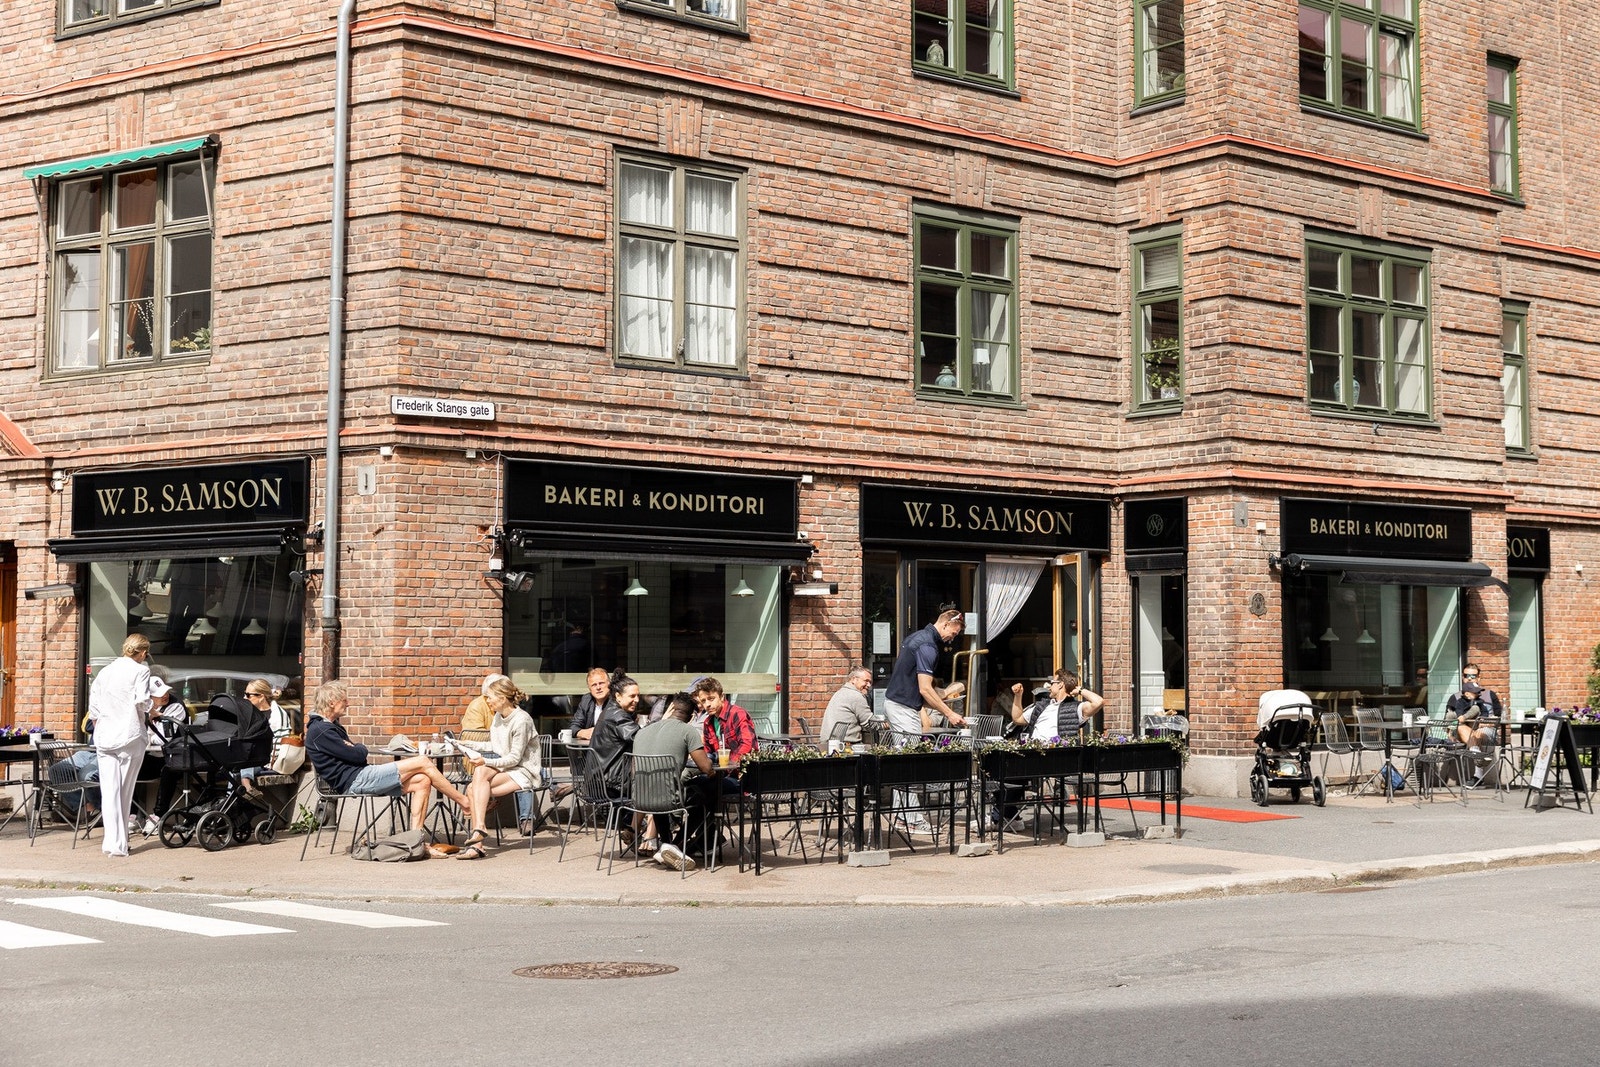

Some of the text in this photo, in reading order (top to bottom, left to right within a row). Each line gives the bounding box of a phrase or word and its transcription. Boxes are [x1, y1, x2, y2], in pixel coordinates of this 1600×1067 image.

[396, 399, 490, 417] Frederik Stangs gate
[96, 477, 283, 517] W. B. SAMSON
[545, 485, 764, 515] BAKERI & KONDITORI
[903, 501, 1074, 536] W. B. SAMSON
[1310, 518, 1448, 540] BAKERI & KONDITORI
